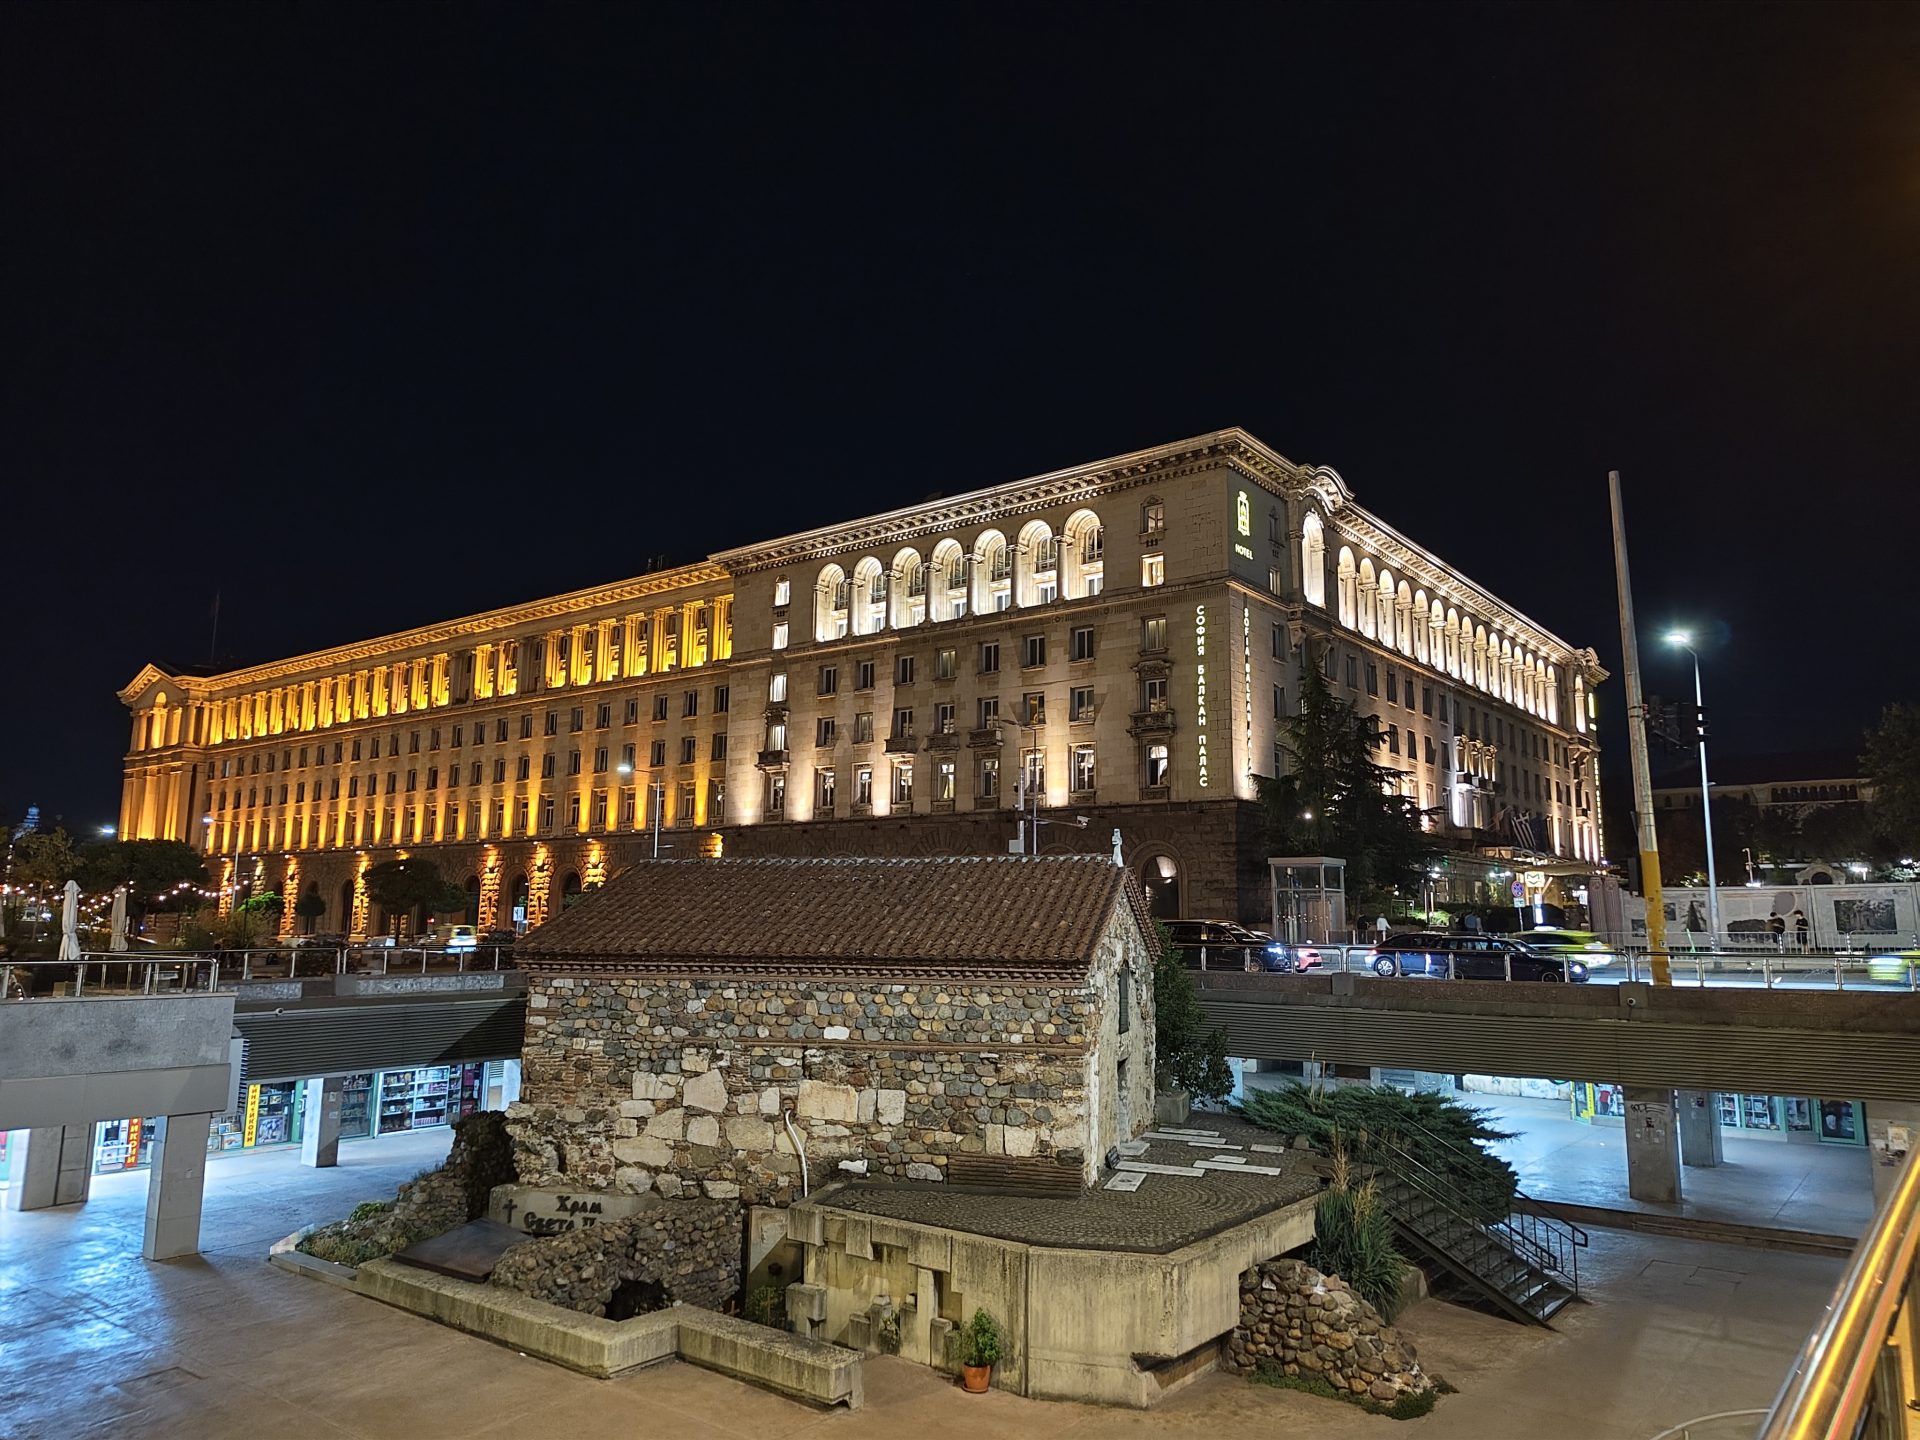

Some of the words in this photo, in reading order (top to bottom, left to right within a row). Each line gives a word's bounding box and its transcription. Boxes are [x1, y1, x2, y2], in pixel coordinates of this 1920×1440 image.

[1235, 543, 1254, 560] HOTEL
[1196, 605, 1206, 656] СОФИЯ
[1197, 664, 1206, 726] БАЛКАН
[1198, 735, 1208, 787] ПАЛАС
